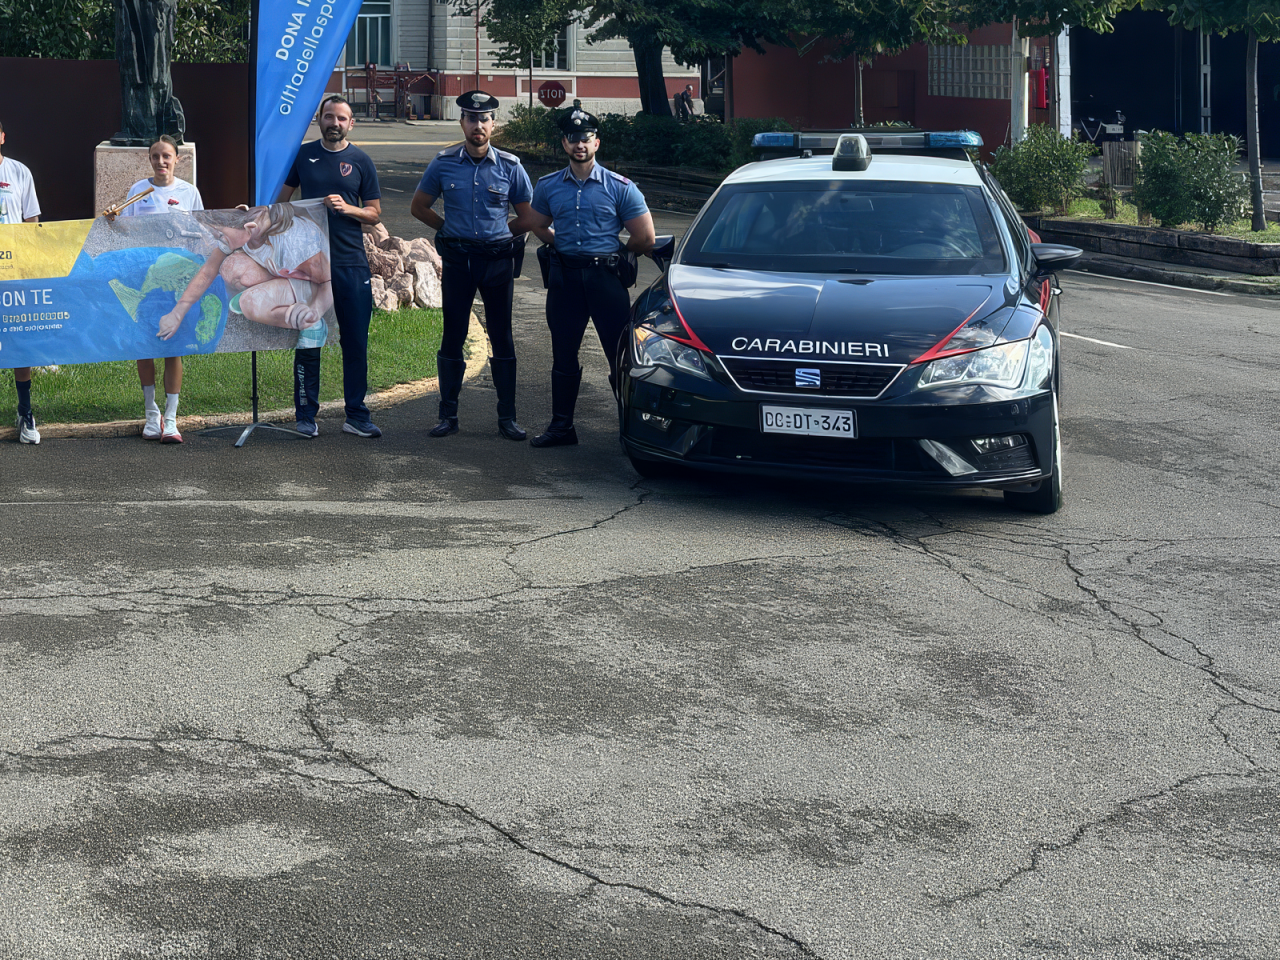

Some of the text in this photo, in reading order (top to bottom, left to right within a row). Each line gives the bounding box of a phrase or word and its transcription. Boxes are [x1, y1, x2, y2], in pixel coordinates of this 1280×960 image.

[275, 12, 307, 61] DONA
[30, 288, 53, 305] TE
[731, 336, 890, 358] CARABINIERI
